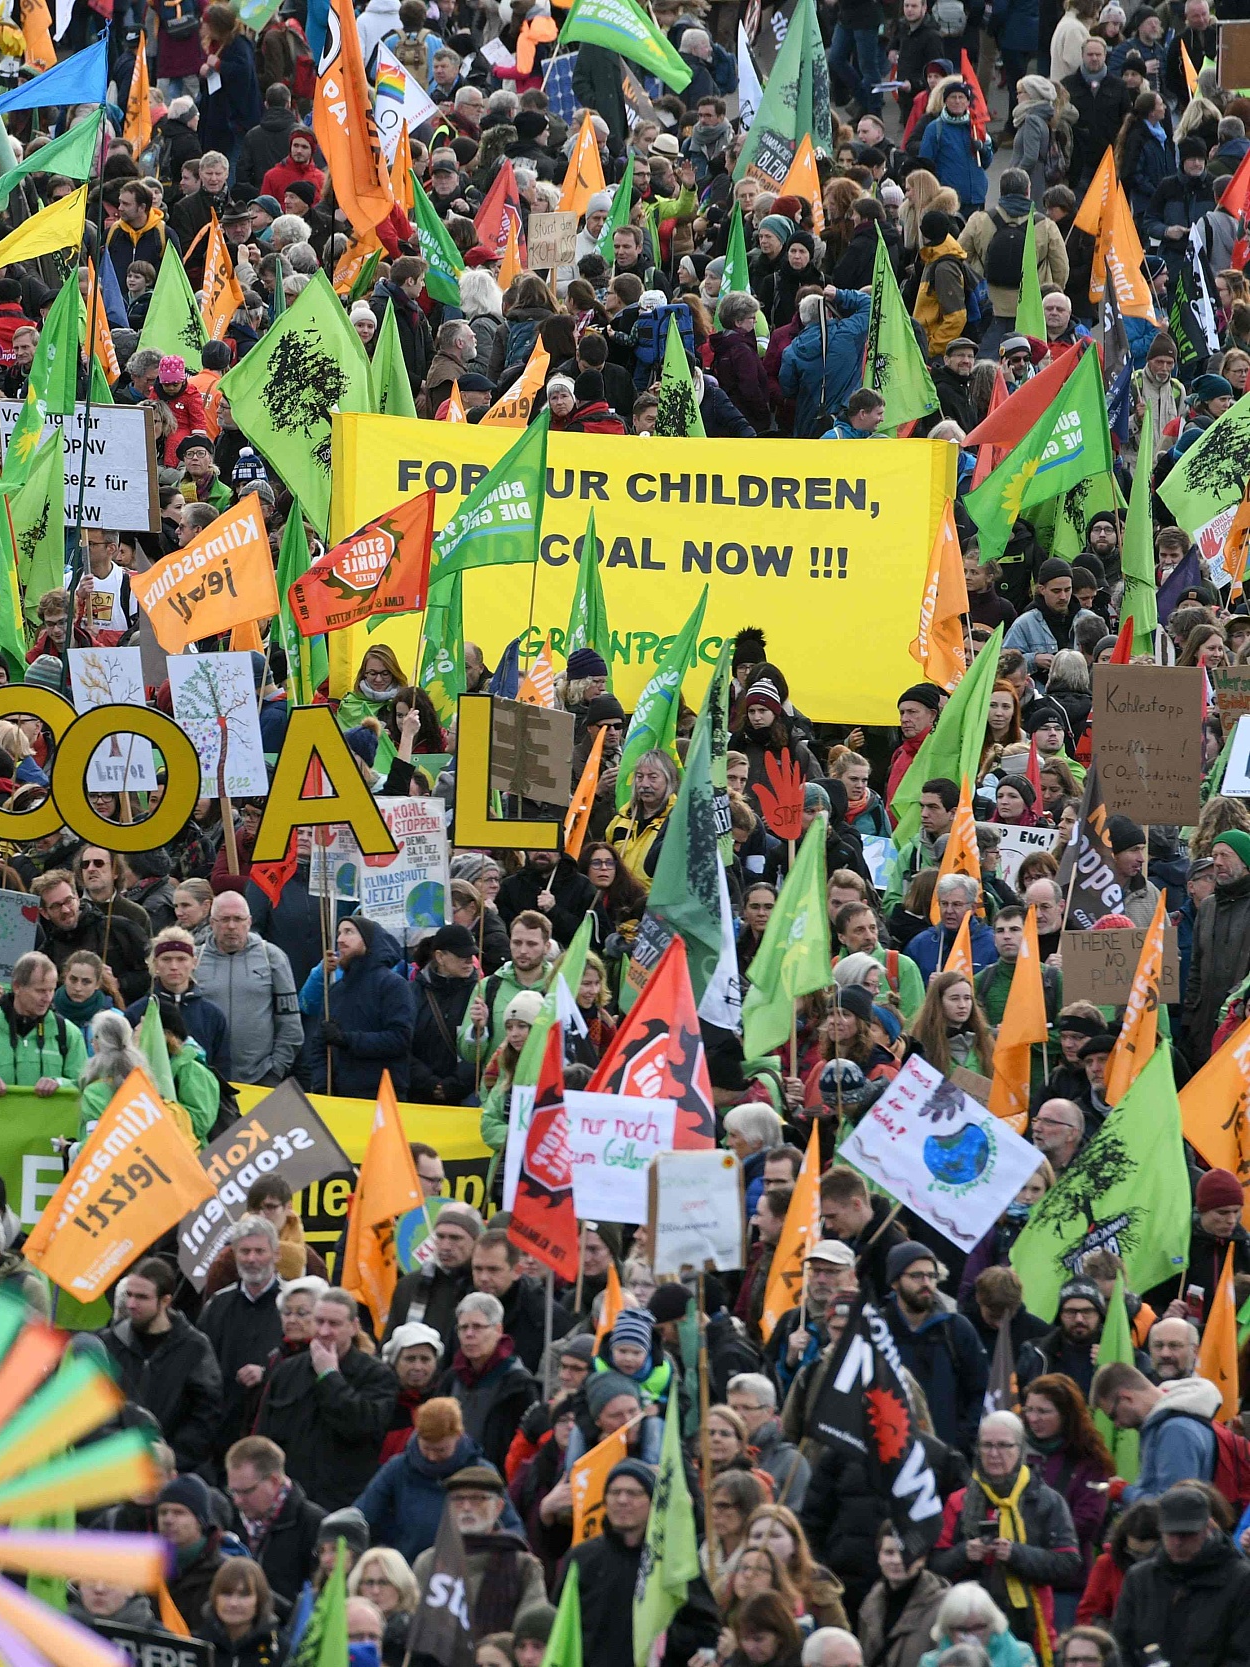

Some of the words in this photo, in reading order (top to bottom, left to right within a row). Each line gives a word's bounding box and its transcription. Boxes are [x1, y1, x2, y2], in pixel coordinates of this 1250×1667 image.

[1, 407, 64, 427] Vong
[104, 474, 129, 491] für
[398, 459, 491, 496] FOR
[625, 471, 881, 520] CHILDREN,
[1213, 517, 1234, 536] STOPP
[539, 533, 665, 571] COAL
[682, 540, 793, 578] NOW
[808, 546, 849, 580] !!!
[1105, 681, 1184, 719] Kohlestopp
[130, 762, 146, 780] OR
[393, 801, 428, 819] KOHLE
[394, 816, 440, 834] STOPPEN!
[363, 868, 428, 888] KLIMASCHUTZ
[364, 884, 405, 904] JETZT!
[1067, 932, 1119, 951] THERE
[1105, 952, 1127, 968] NO
[580, 1116, 607, 1136] nur
